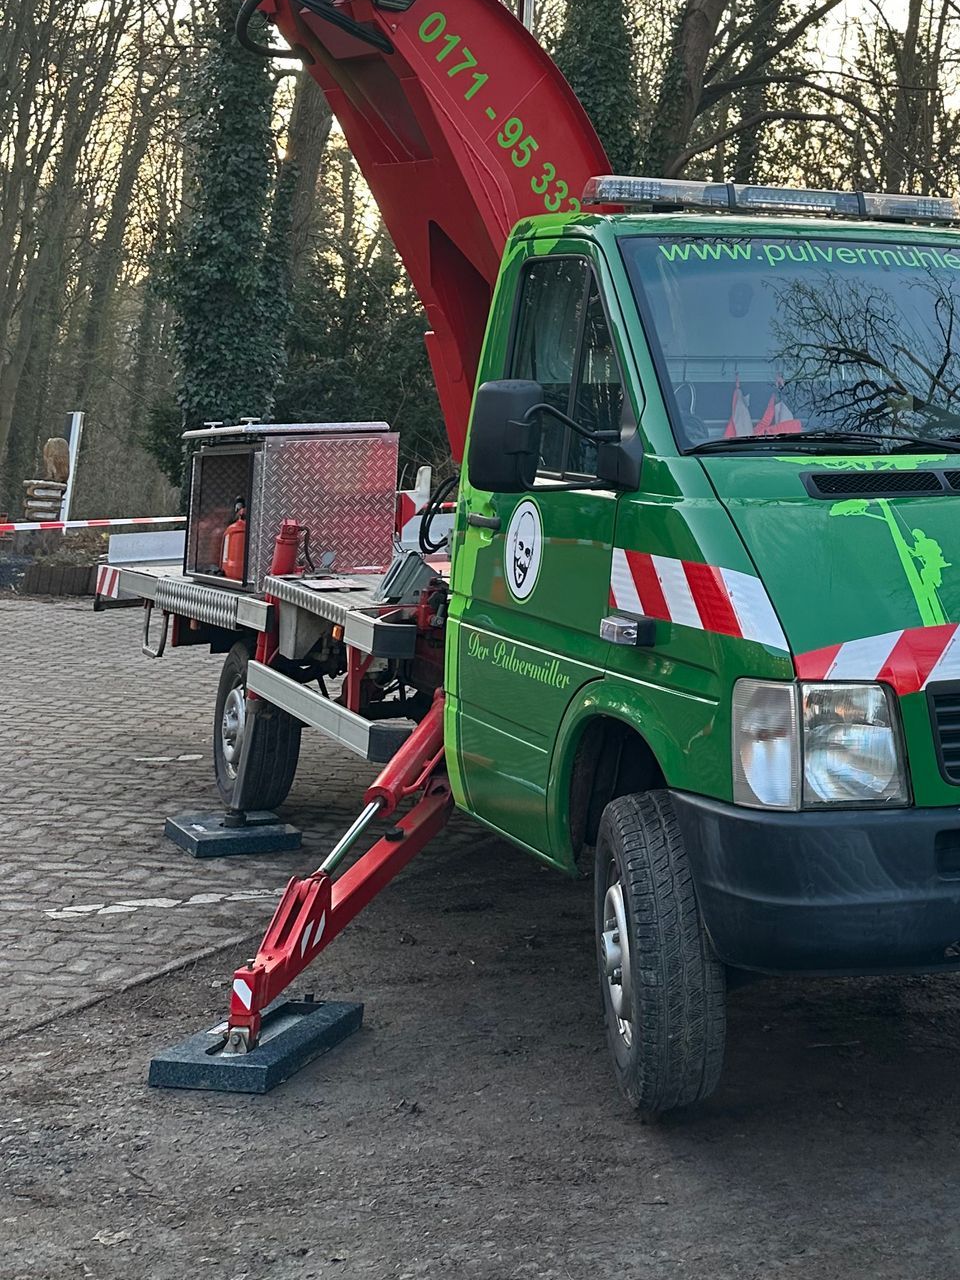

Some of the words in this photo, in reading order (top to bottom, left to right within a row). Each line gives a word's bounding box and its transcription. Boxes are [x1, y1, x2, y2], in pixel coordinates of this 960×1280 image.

[418, 11, 490, 101] 0171
[497, 117, 539, 168] 95
[468, 631, 489, 660] Der
[492, 640, 571, 690] Pulvermüller
